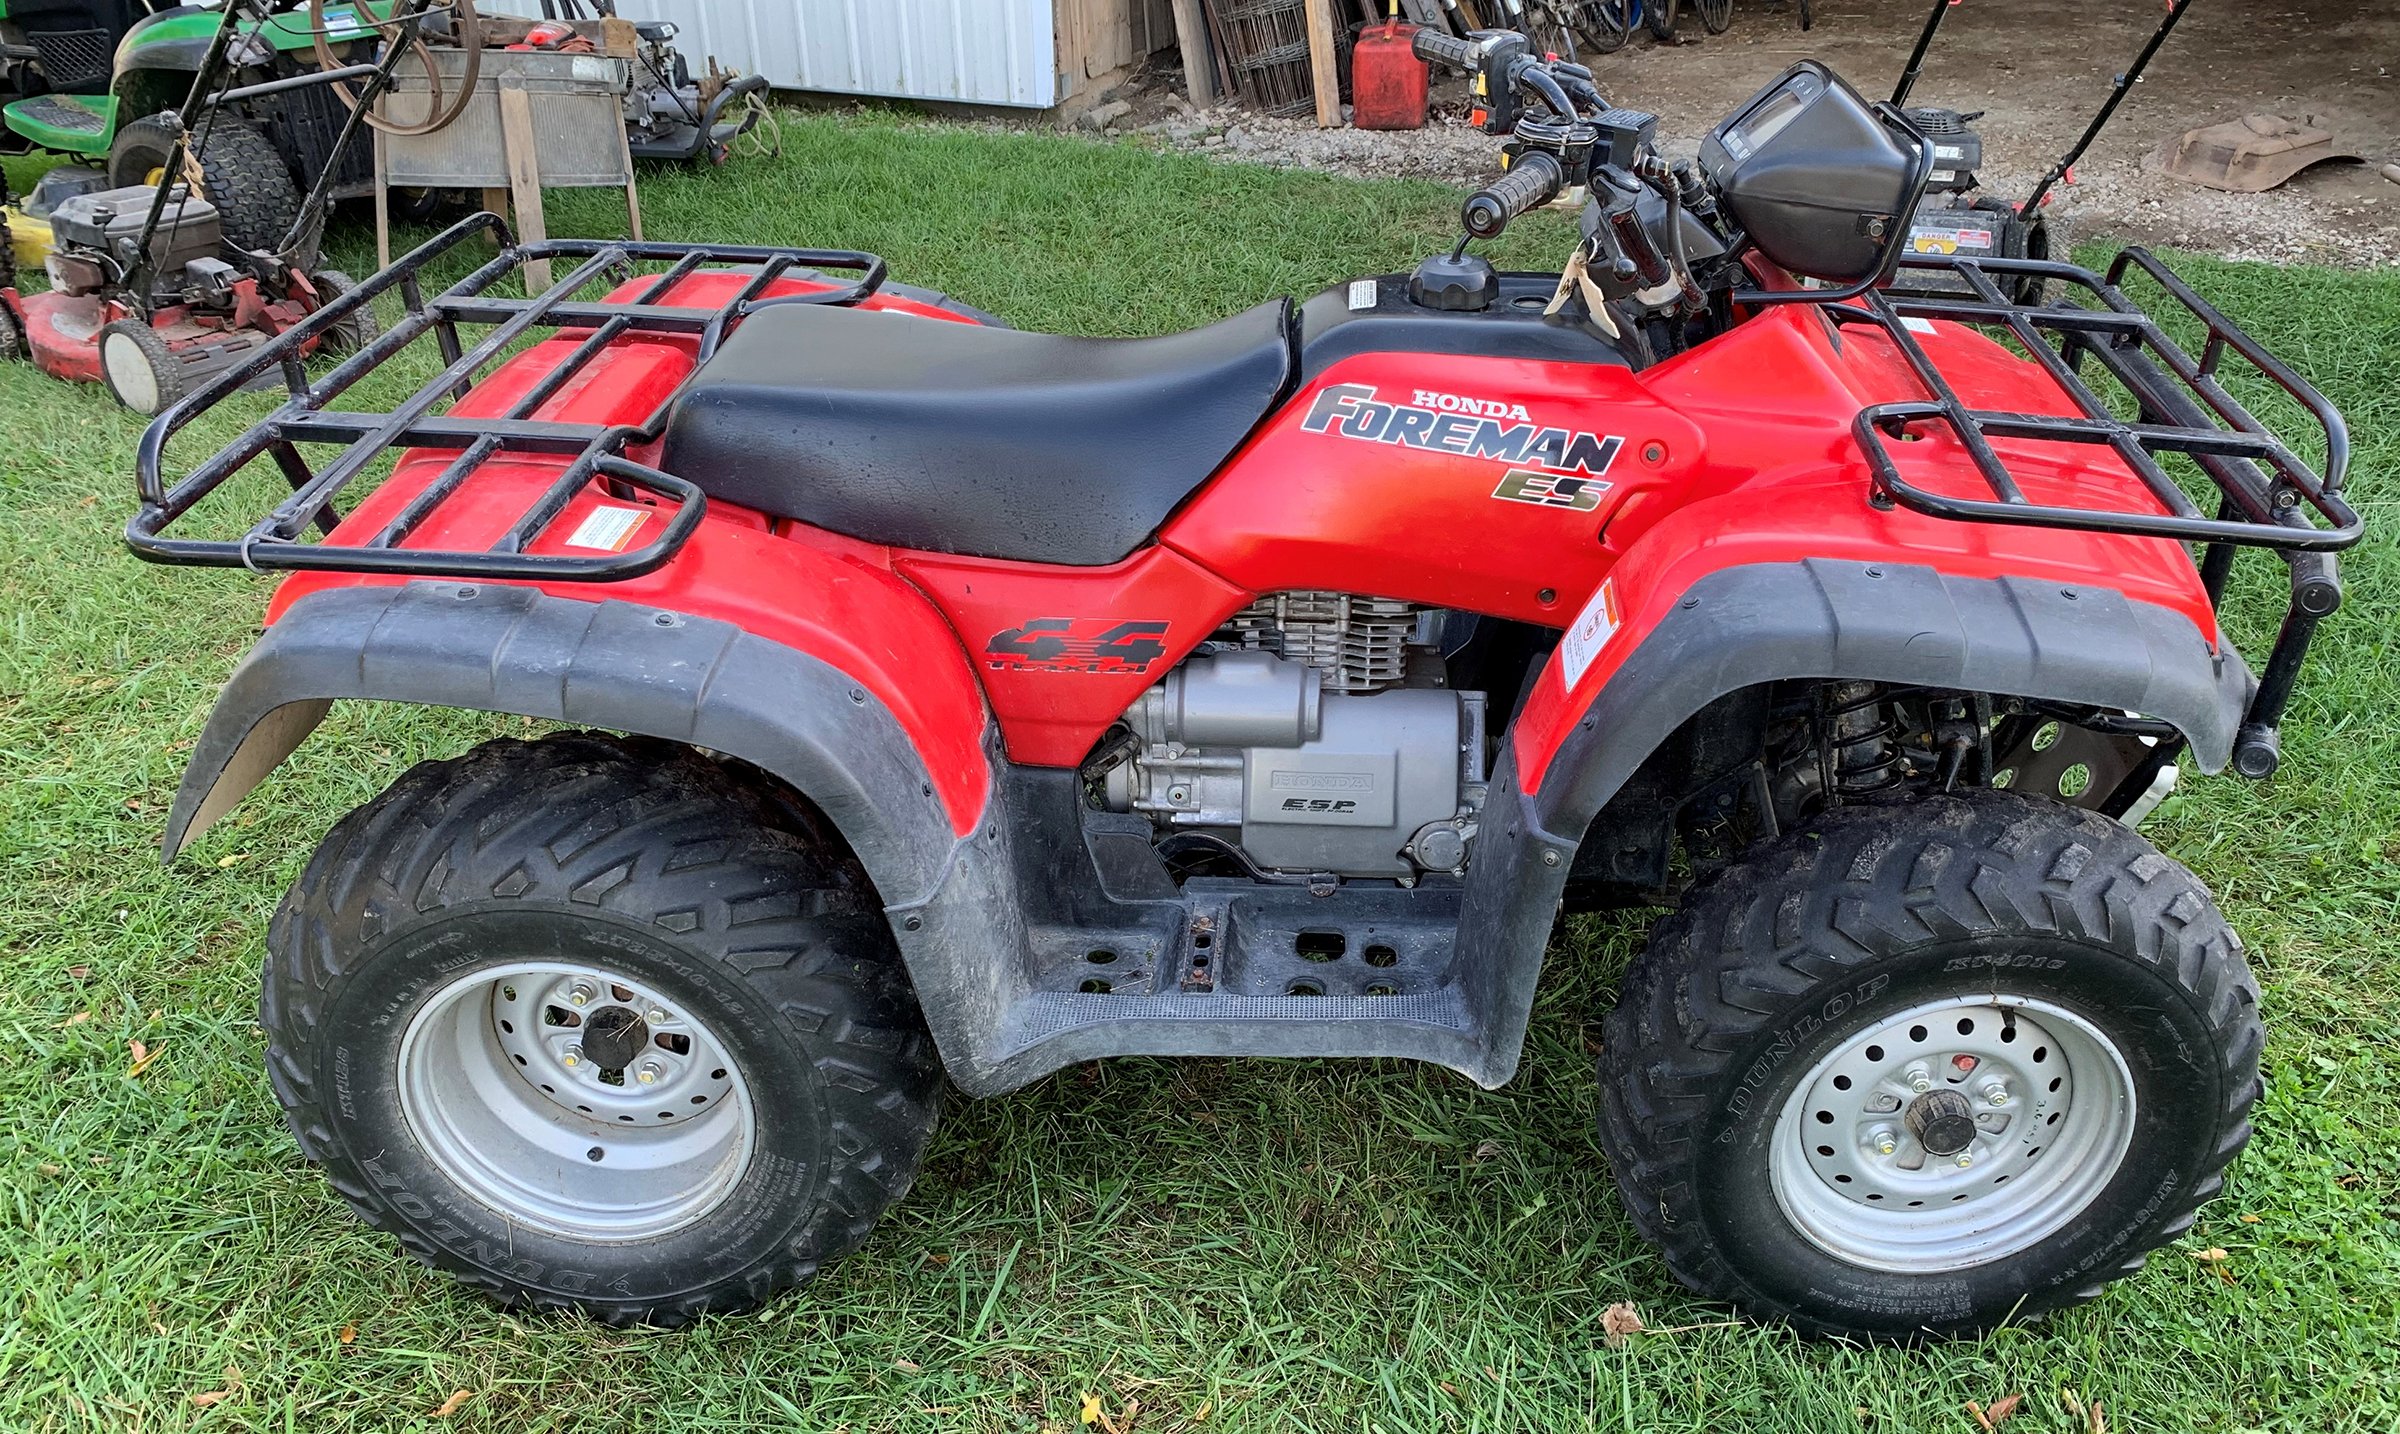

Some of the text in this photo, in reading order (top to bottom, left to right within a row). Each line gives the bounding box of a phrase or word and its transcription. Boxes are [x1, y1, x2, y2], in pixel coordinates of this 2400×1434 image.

[1299, 381, 1627, 476] FOREMAN
[1412, 389, 1532, 422] HONDA
[1490, 467, 1615, 513] ES
[1274, 774, 1371, 789] HONDA
[1282, 798, 1357, 809] ESP
[1727, 973, 1890, 1121] DUNLOP
[362, 1157, 598, 1292] DUNLOP
